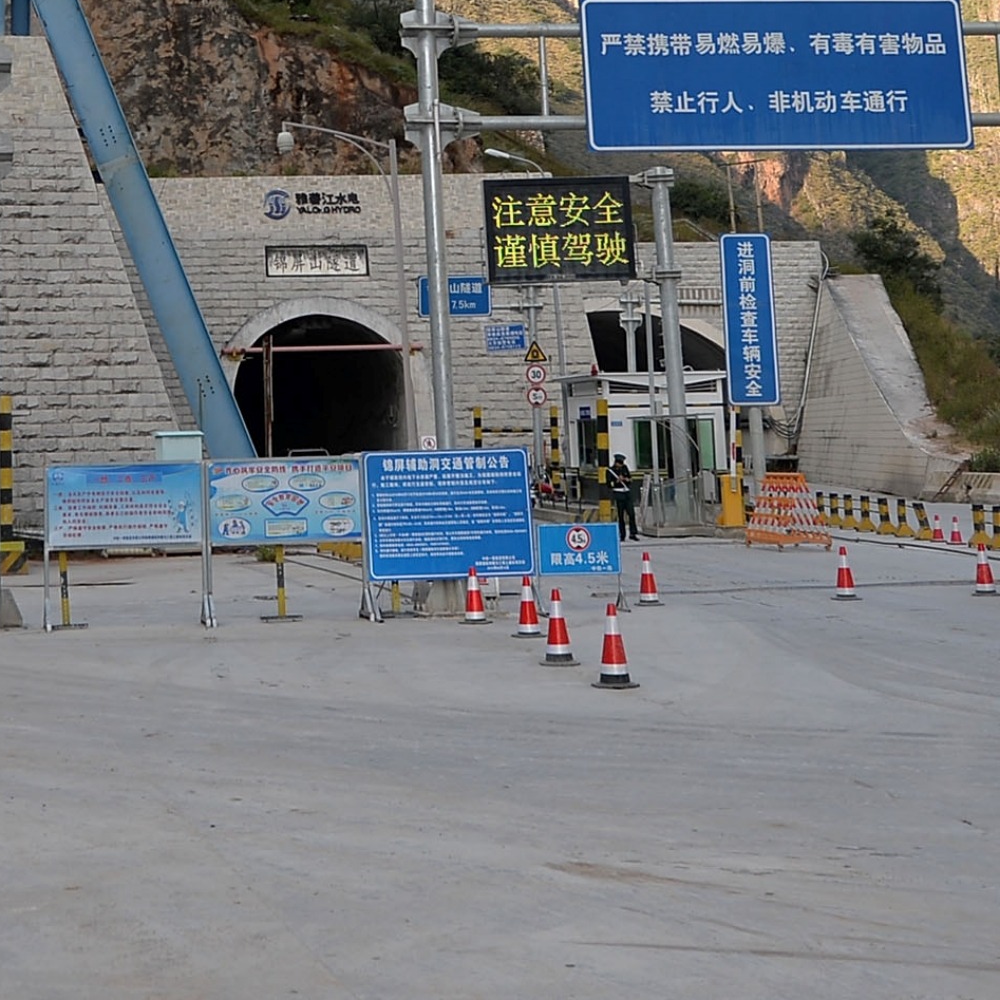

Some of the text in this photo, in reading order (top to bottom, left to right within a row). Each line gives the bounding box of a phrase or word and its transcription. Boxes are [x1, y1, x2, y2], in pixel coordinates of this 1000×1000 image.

[600, 32, 947, 56] 严禁携带易燃易爆、有毒有害物品
[650, 89, 909, 114] 禁止行人、非机动车通行
[491, 191, 624, 228] 注意安全
[493, 232, 630, 268] 谨慎驾驶
[451, 300, 476, 309] 7.5km
[736, 241, 763, 397] 进洞前检查车辆安全
[531, 370, 542, 379] 30
[550, 550, 609, 566] 限高4.5米
